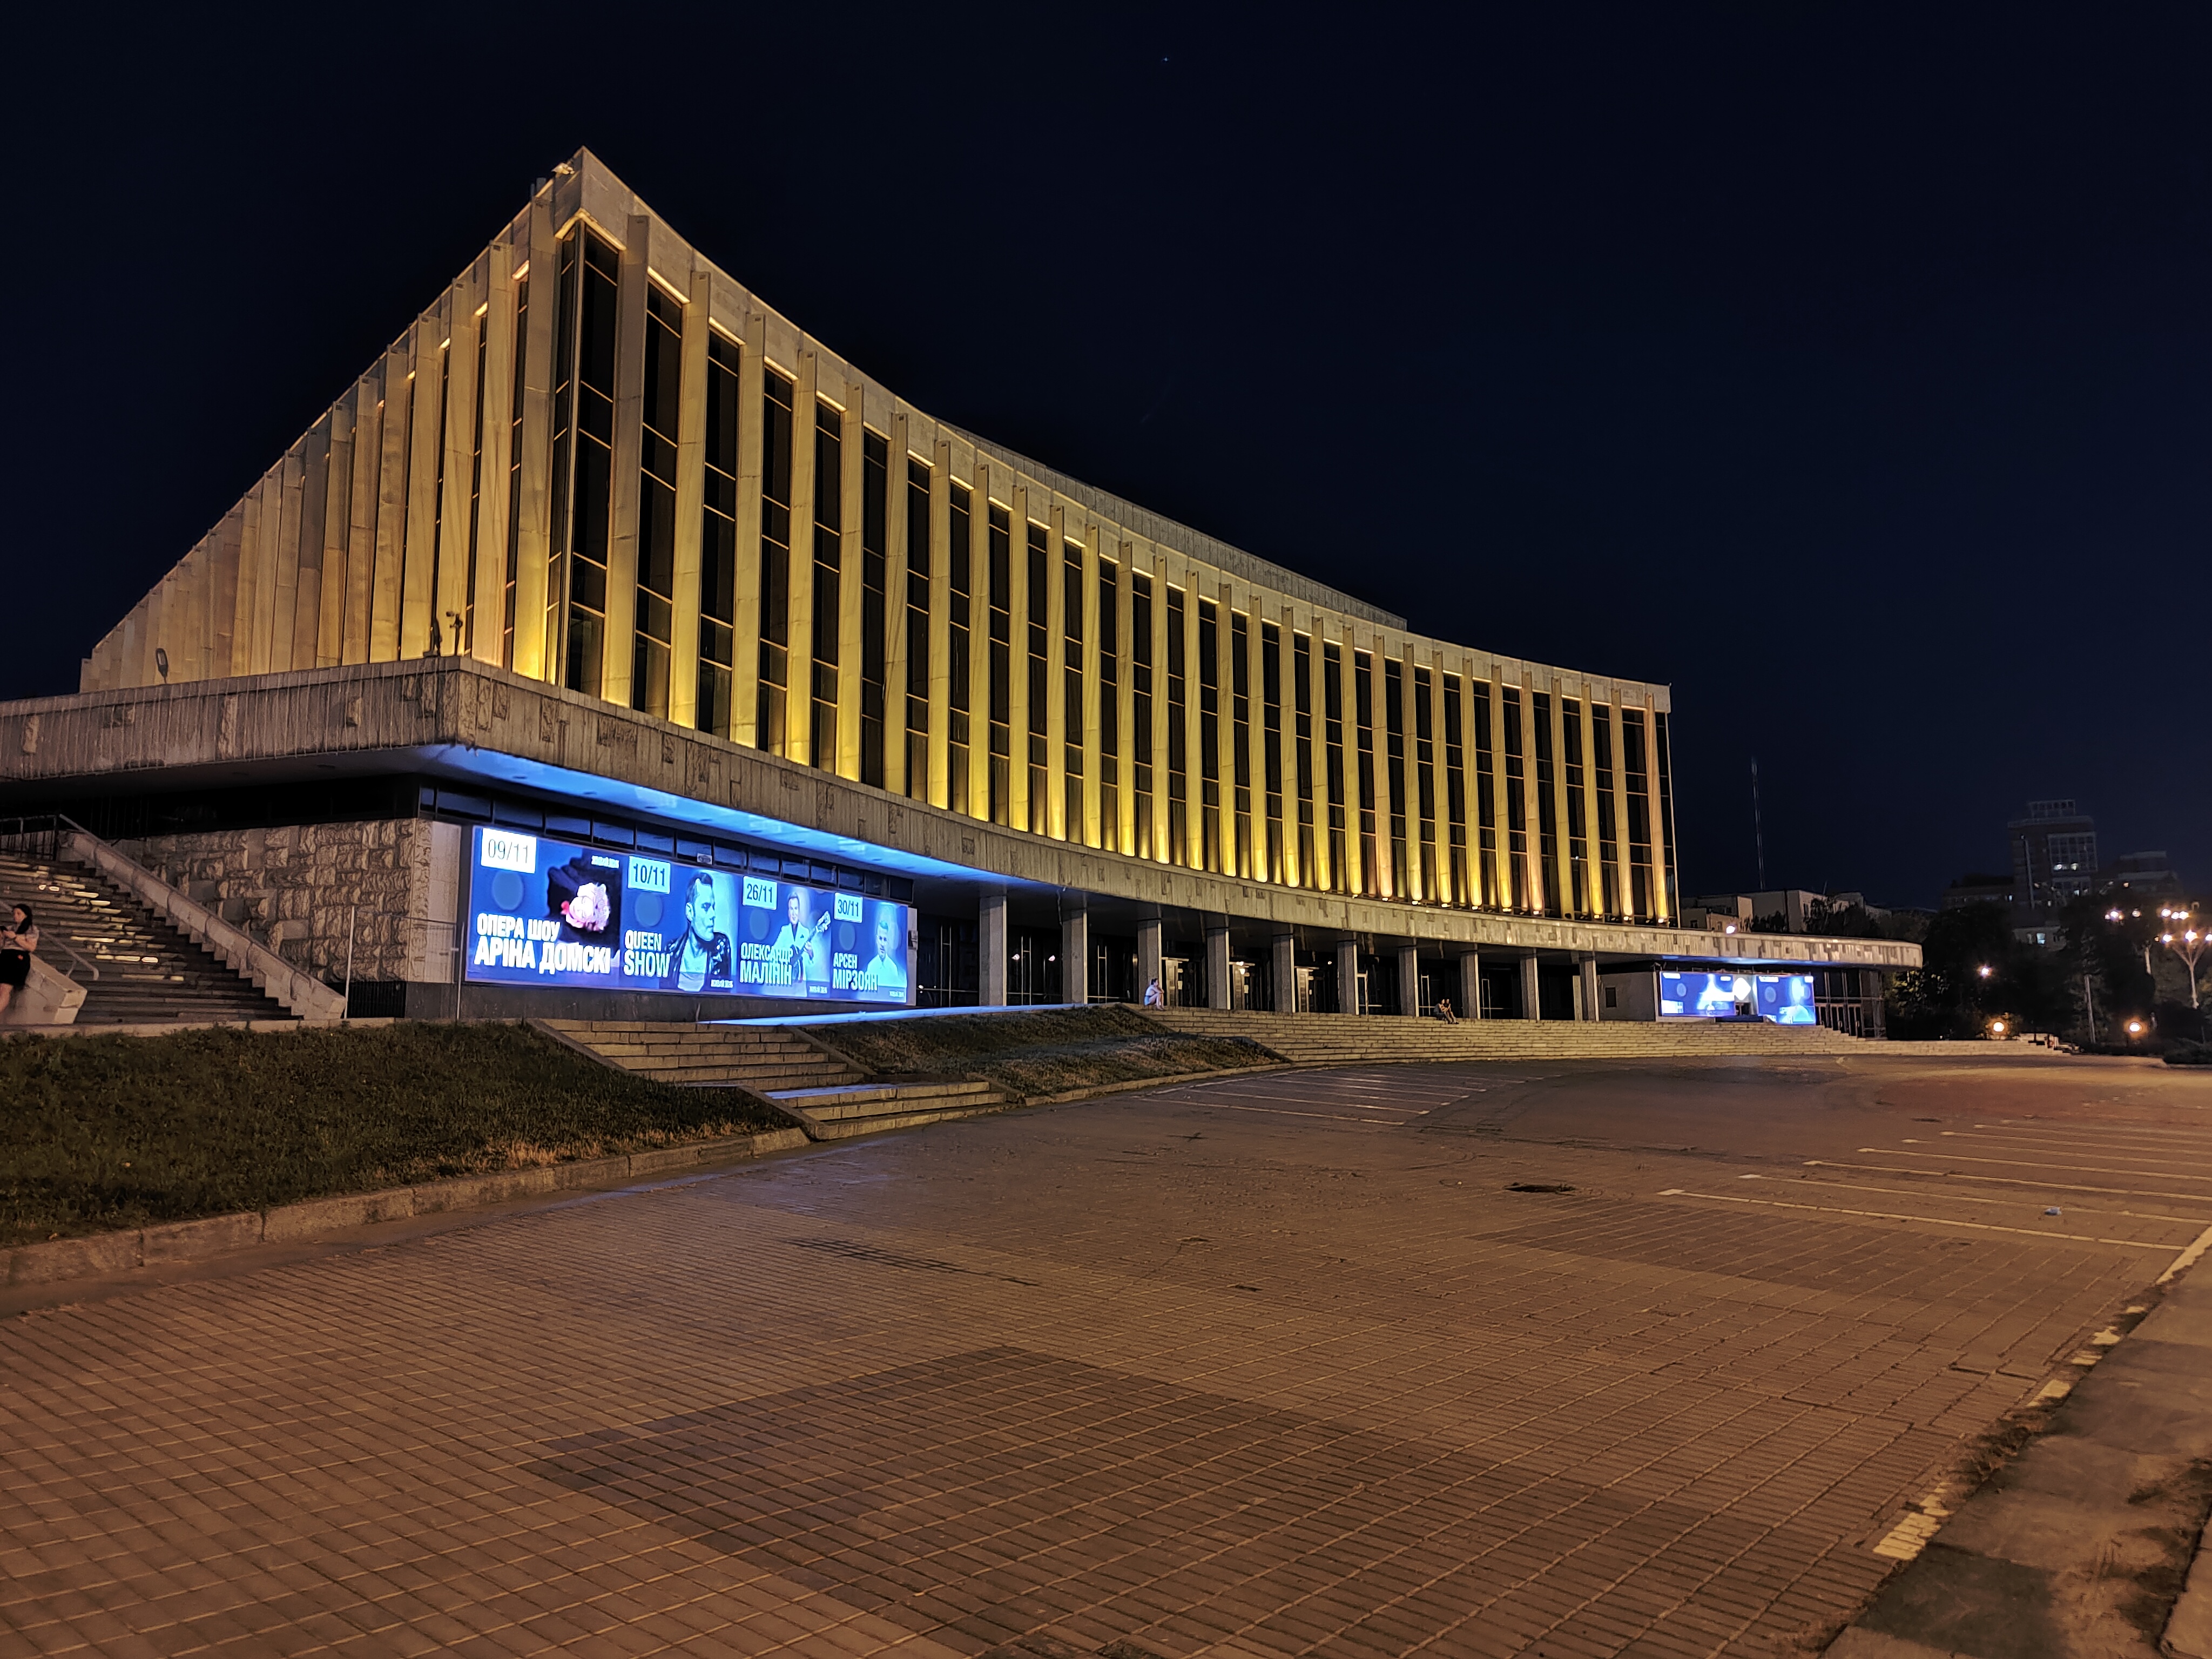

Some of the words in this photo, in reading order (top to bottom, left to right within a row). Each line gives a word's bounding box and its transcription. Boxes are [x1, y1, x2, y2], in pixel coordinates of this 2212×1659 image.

[488, 839, 528, 864] 09/11
[633, 864, 665, 886] 10/11
[746, 884, 773, 903] 26/11
[838, 900, 859, 918] 30/11
[477, 913, 524, 939] ОПЕРА
[528, 919, 561, 942] ШОУ
[625, 929, 662, 951] QUEEN
[474, 935, 536, 968] АРІНА
[539, 941, 611, 974] ДОМСКІ
[624, 950, 670, 977] SHOW
[740, 942, 793, 965] ОЛЕКСАНДР
[833, 952, 858, 969] АРСЕН
[740, 961, 792, 986] МАЛІНІН
[833, 969, 878, 991] МІРЗОЯН
